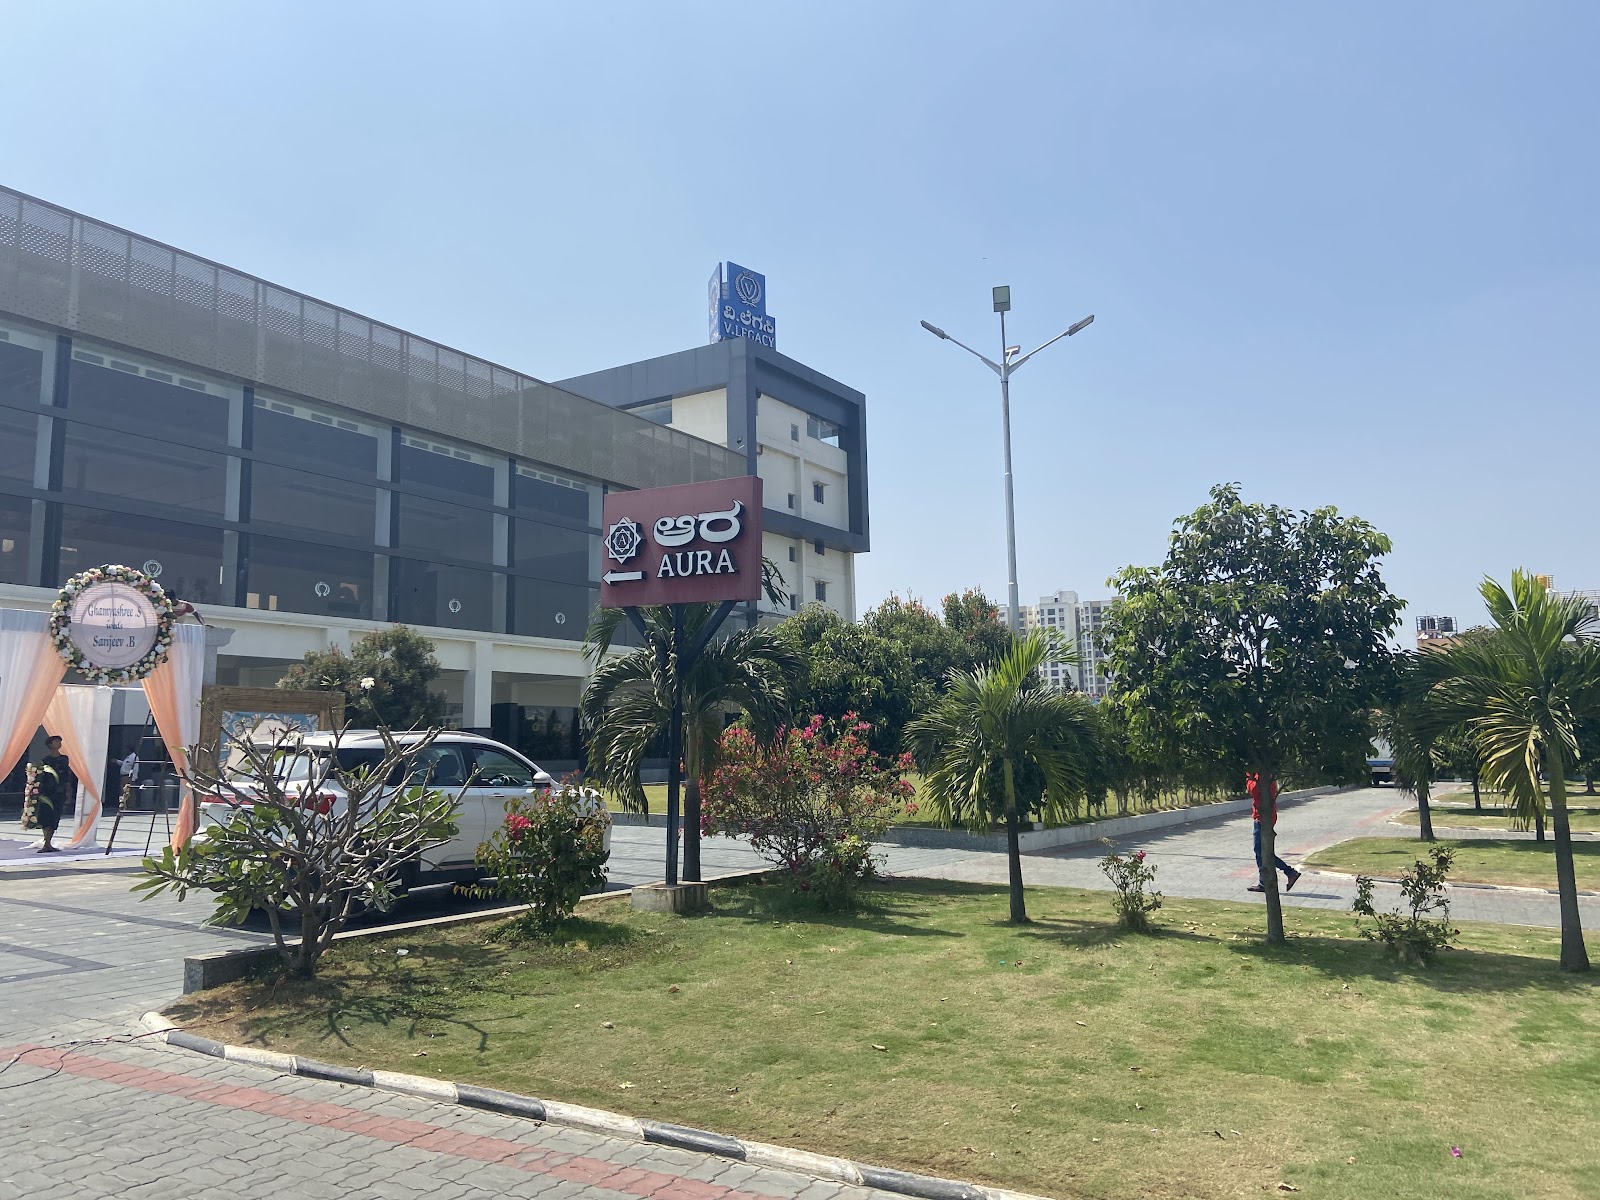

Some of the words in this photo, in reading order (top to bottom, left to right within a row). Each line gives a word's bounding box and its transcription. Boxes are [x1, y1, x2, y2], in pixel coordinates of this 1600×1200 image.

[653, 498, 745, 548] ಆರ
[618, 534, 627, 546] A
[656, 548, 736, 578] AURA
[92, 634, 125, 653] Sanjeev
